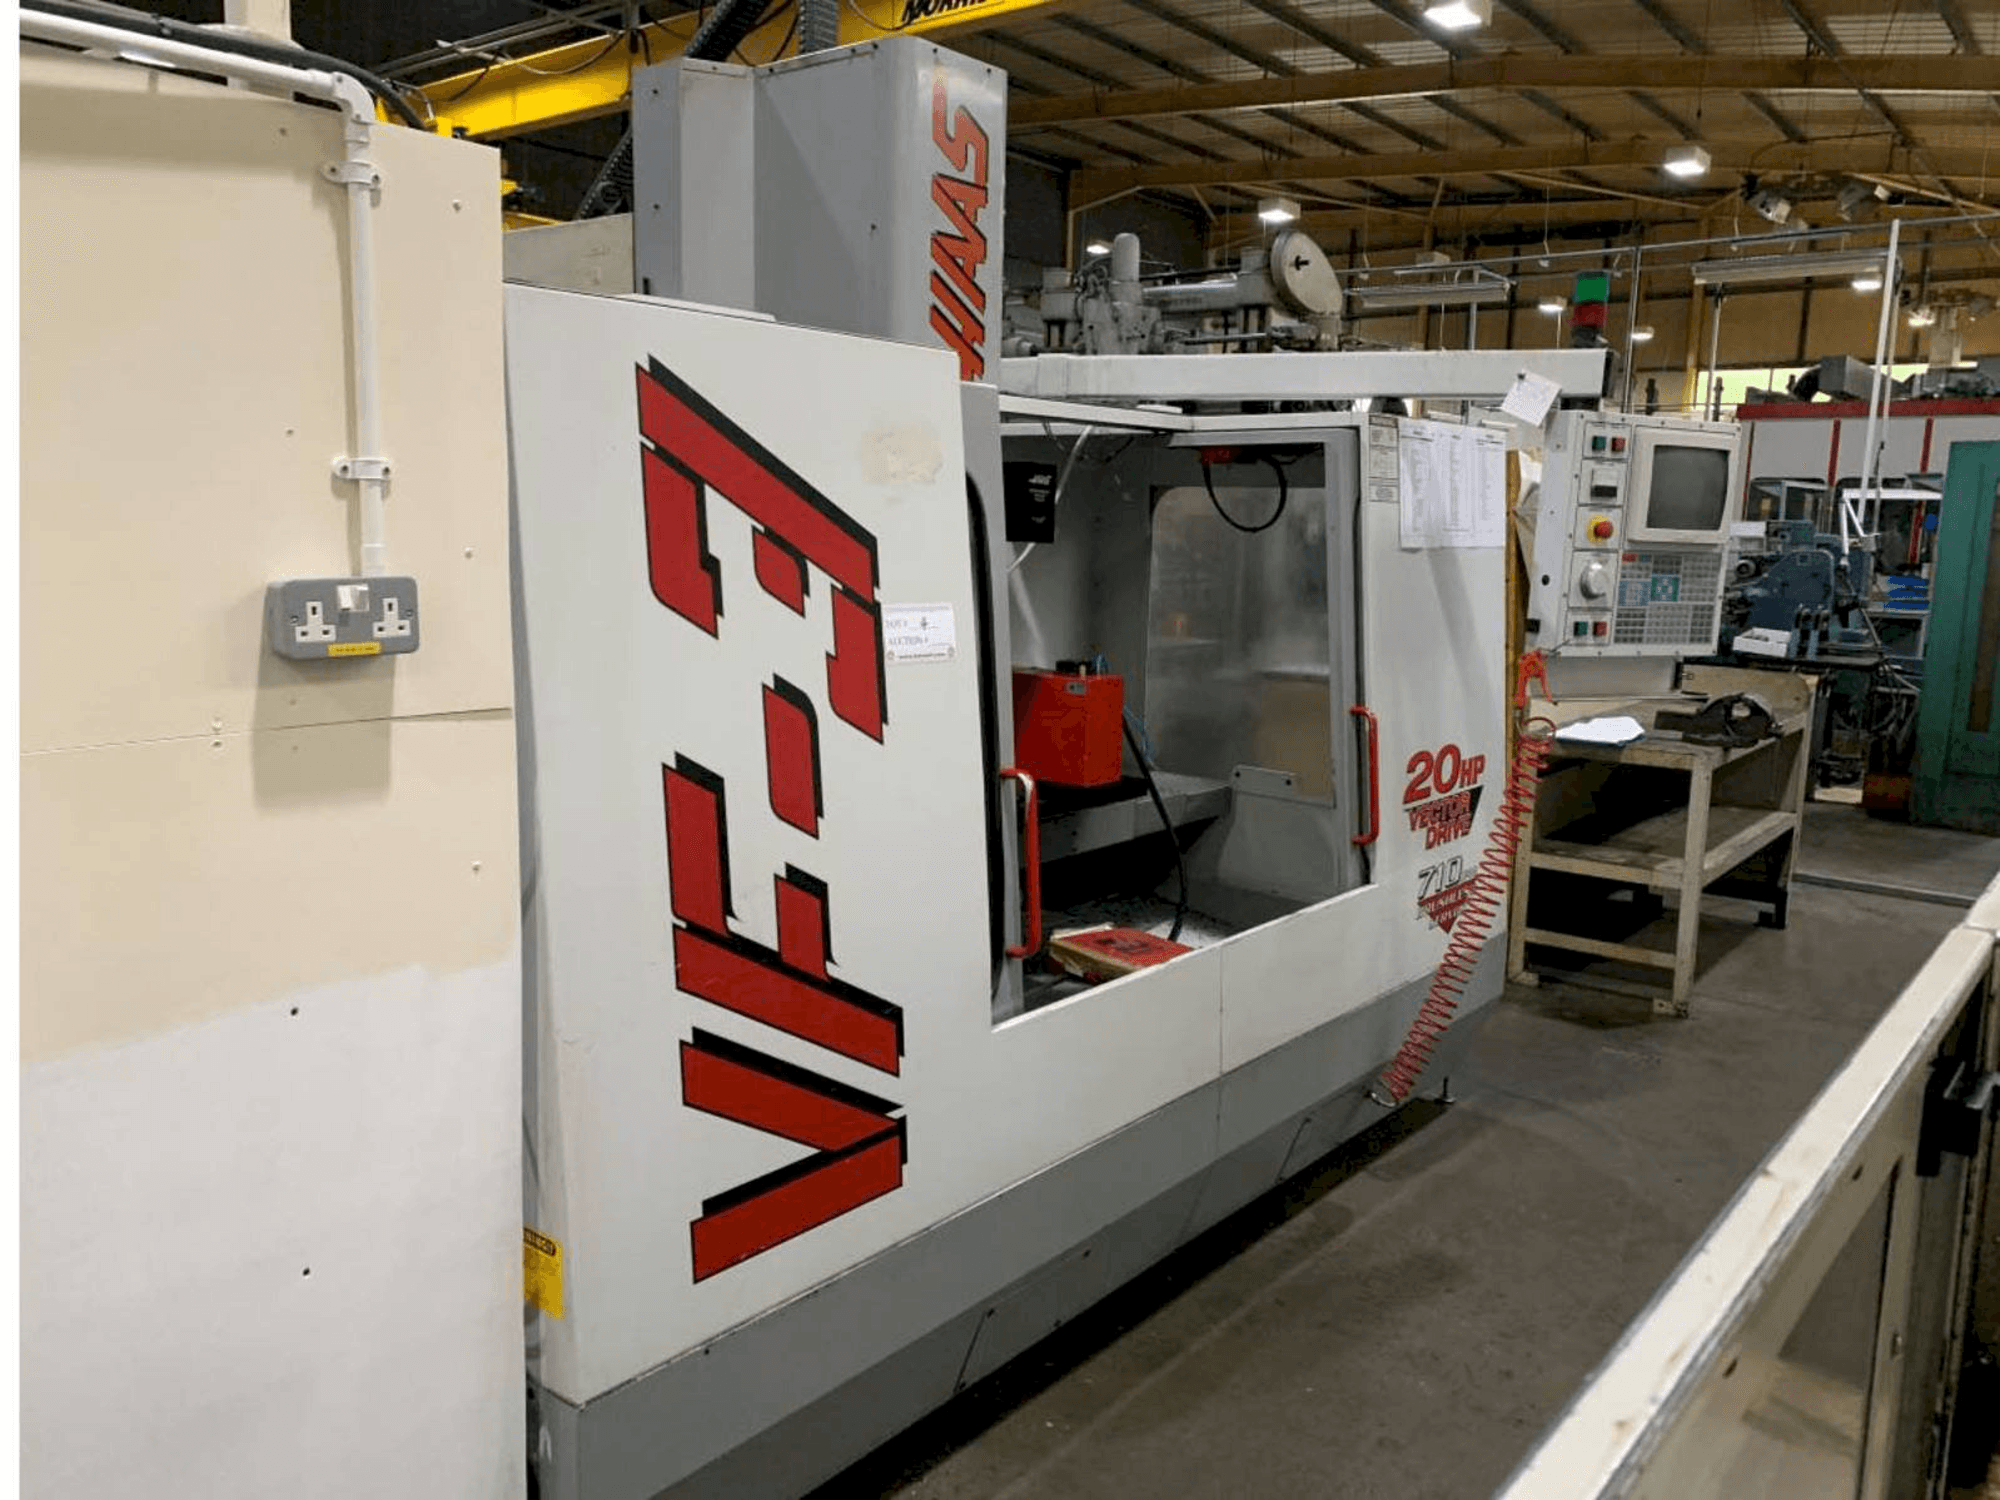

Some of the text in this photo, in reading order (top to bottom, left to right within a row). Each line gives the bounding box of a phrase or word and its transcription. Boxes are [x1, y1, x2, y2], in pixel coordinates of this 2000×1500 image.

[929, 66, 989, 381] HAAS
[635, 353, 908, 1285] VF-3
[1408, 789, 1472, 833] VECTOR
[1425, 814, 1472, 851] DRIVE
[1417, 855, 1463, 901] 710
